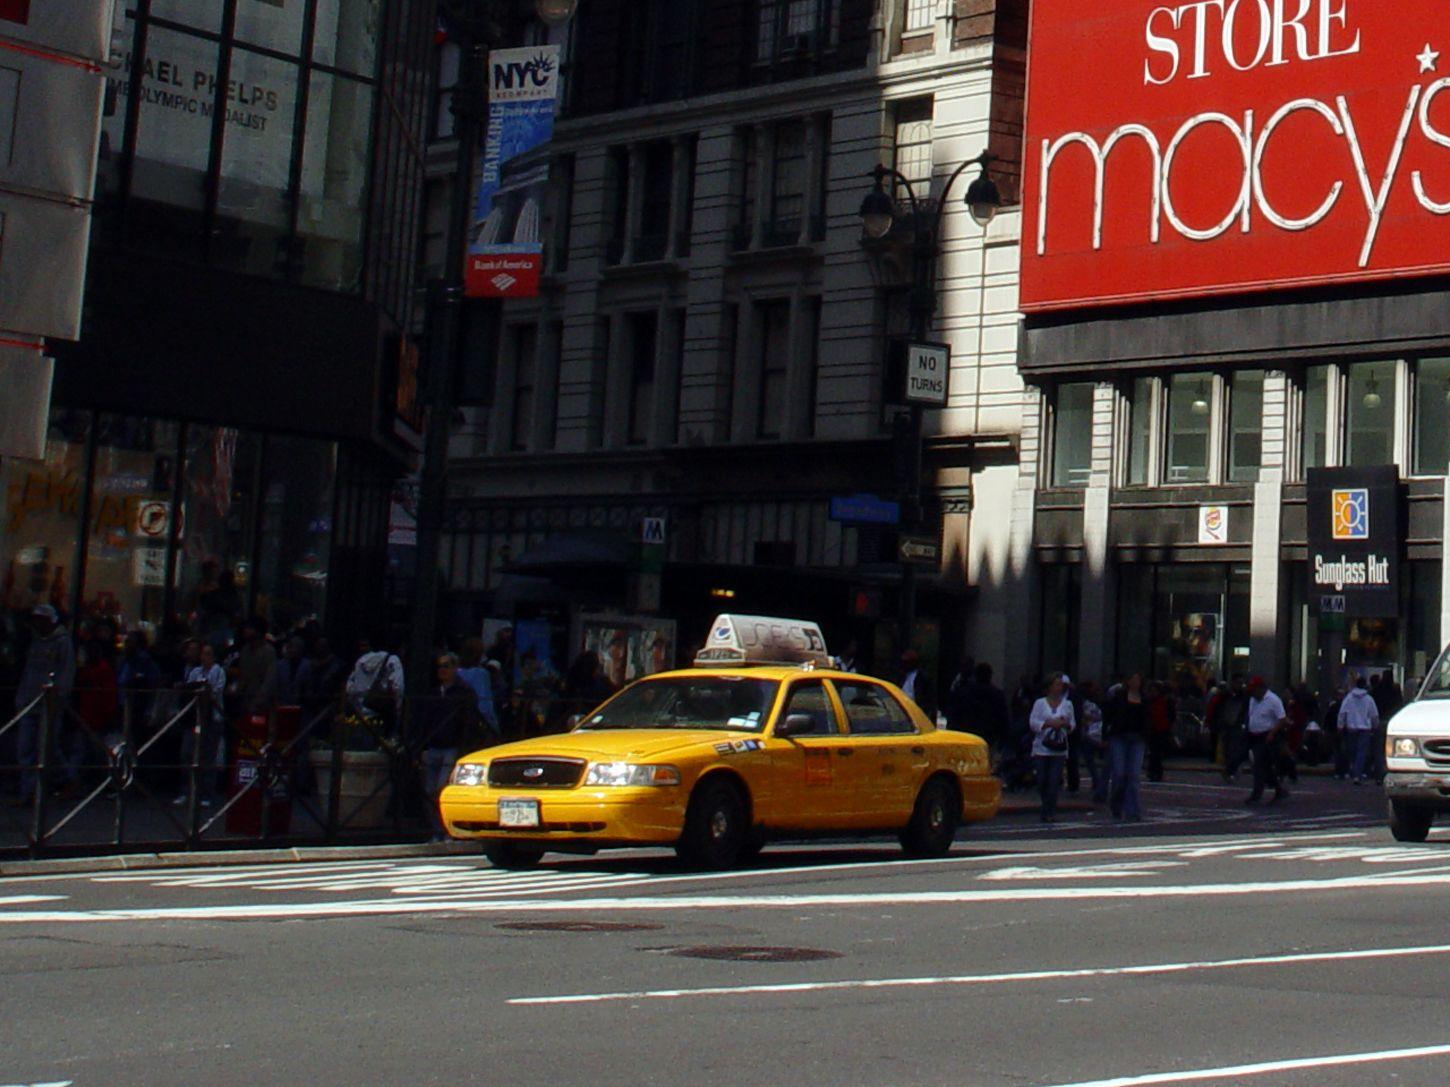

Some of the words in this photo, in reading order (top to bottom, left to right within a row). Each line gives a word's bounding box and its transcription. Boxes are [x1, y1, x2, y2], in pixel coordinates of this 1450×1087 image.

[494, 61, 550, 90] NYC
[200, 102, 267, 131] MDALIST
[483, 106, 504, 183] BANKING
[503, 259, 533, 271] America
[919, 356, 936, 370] NO
[911, 377, 942, 392] TURNS
[1315, 554, 1366, 592] Sunglass
[1368, 554, 1389, 584] Hut
